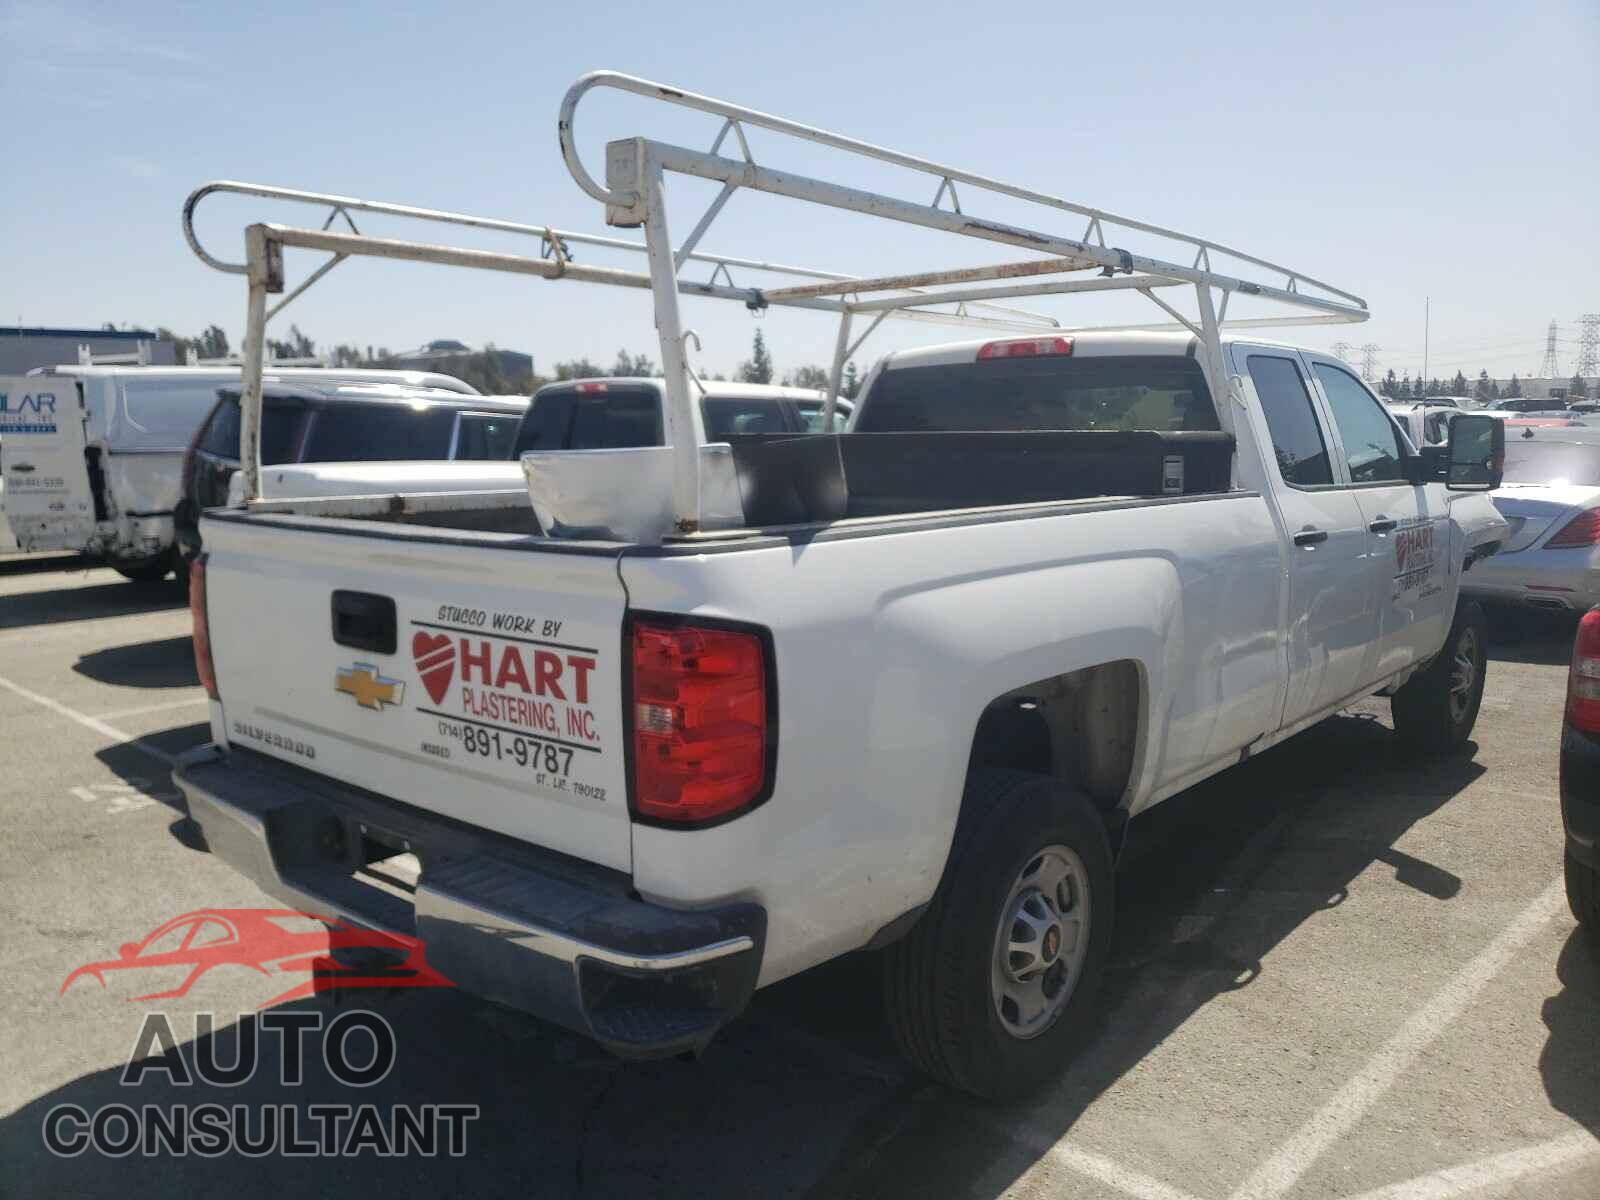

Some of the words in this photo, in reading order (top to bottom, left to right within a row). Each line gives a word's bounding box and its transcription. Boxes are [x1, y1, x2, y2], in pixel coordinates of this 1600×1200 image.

[1407, 527, 1434, 553] HART
[438, 605, 487, 626] STUCCO
[492, 613, 536, 633] WORK
[542, 620, 562, 638] BY
[459, 637, 596, 704] HART
[462, 687, 561, 737] PLASTERING,
[566, 707, 601, 741] INC.
